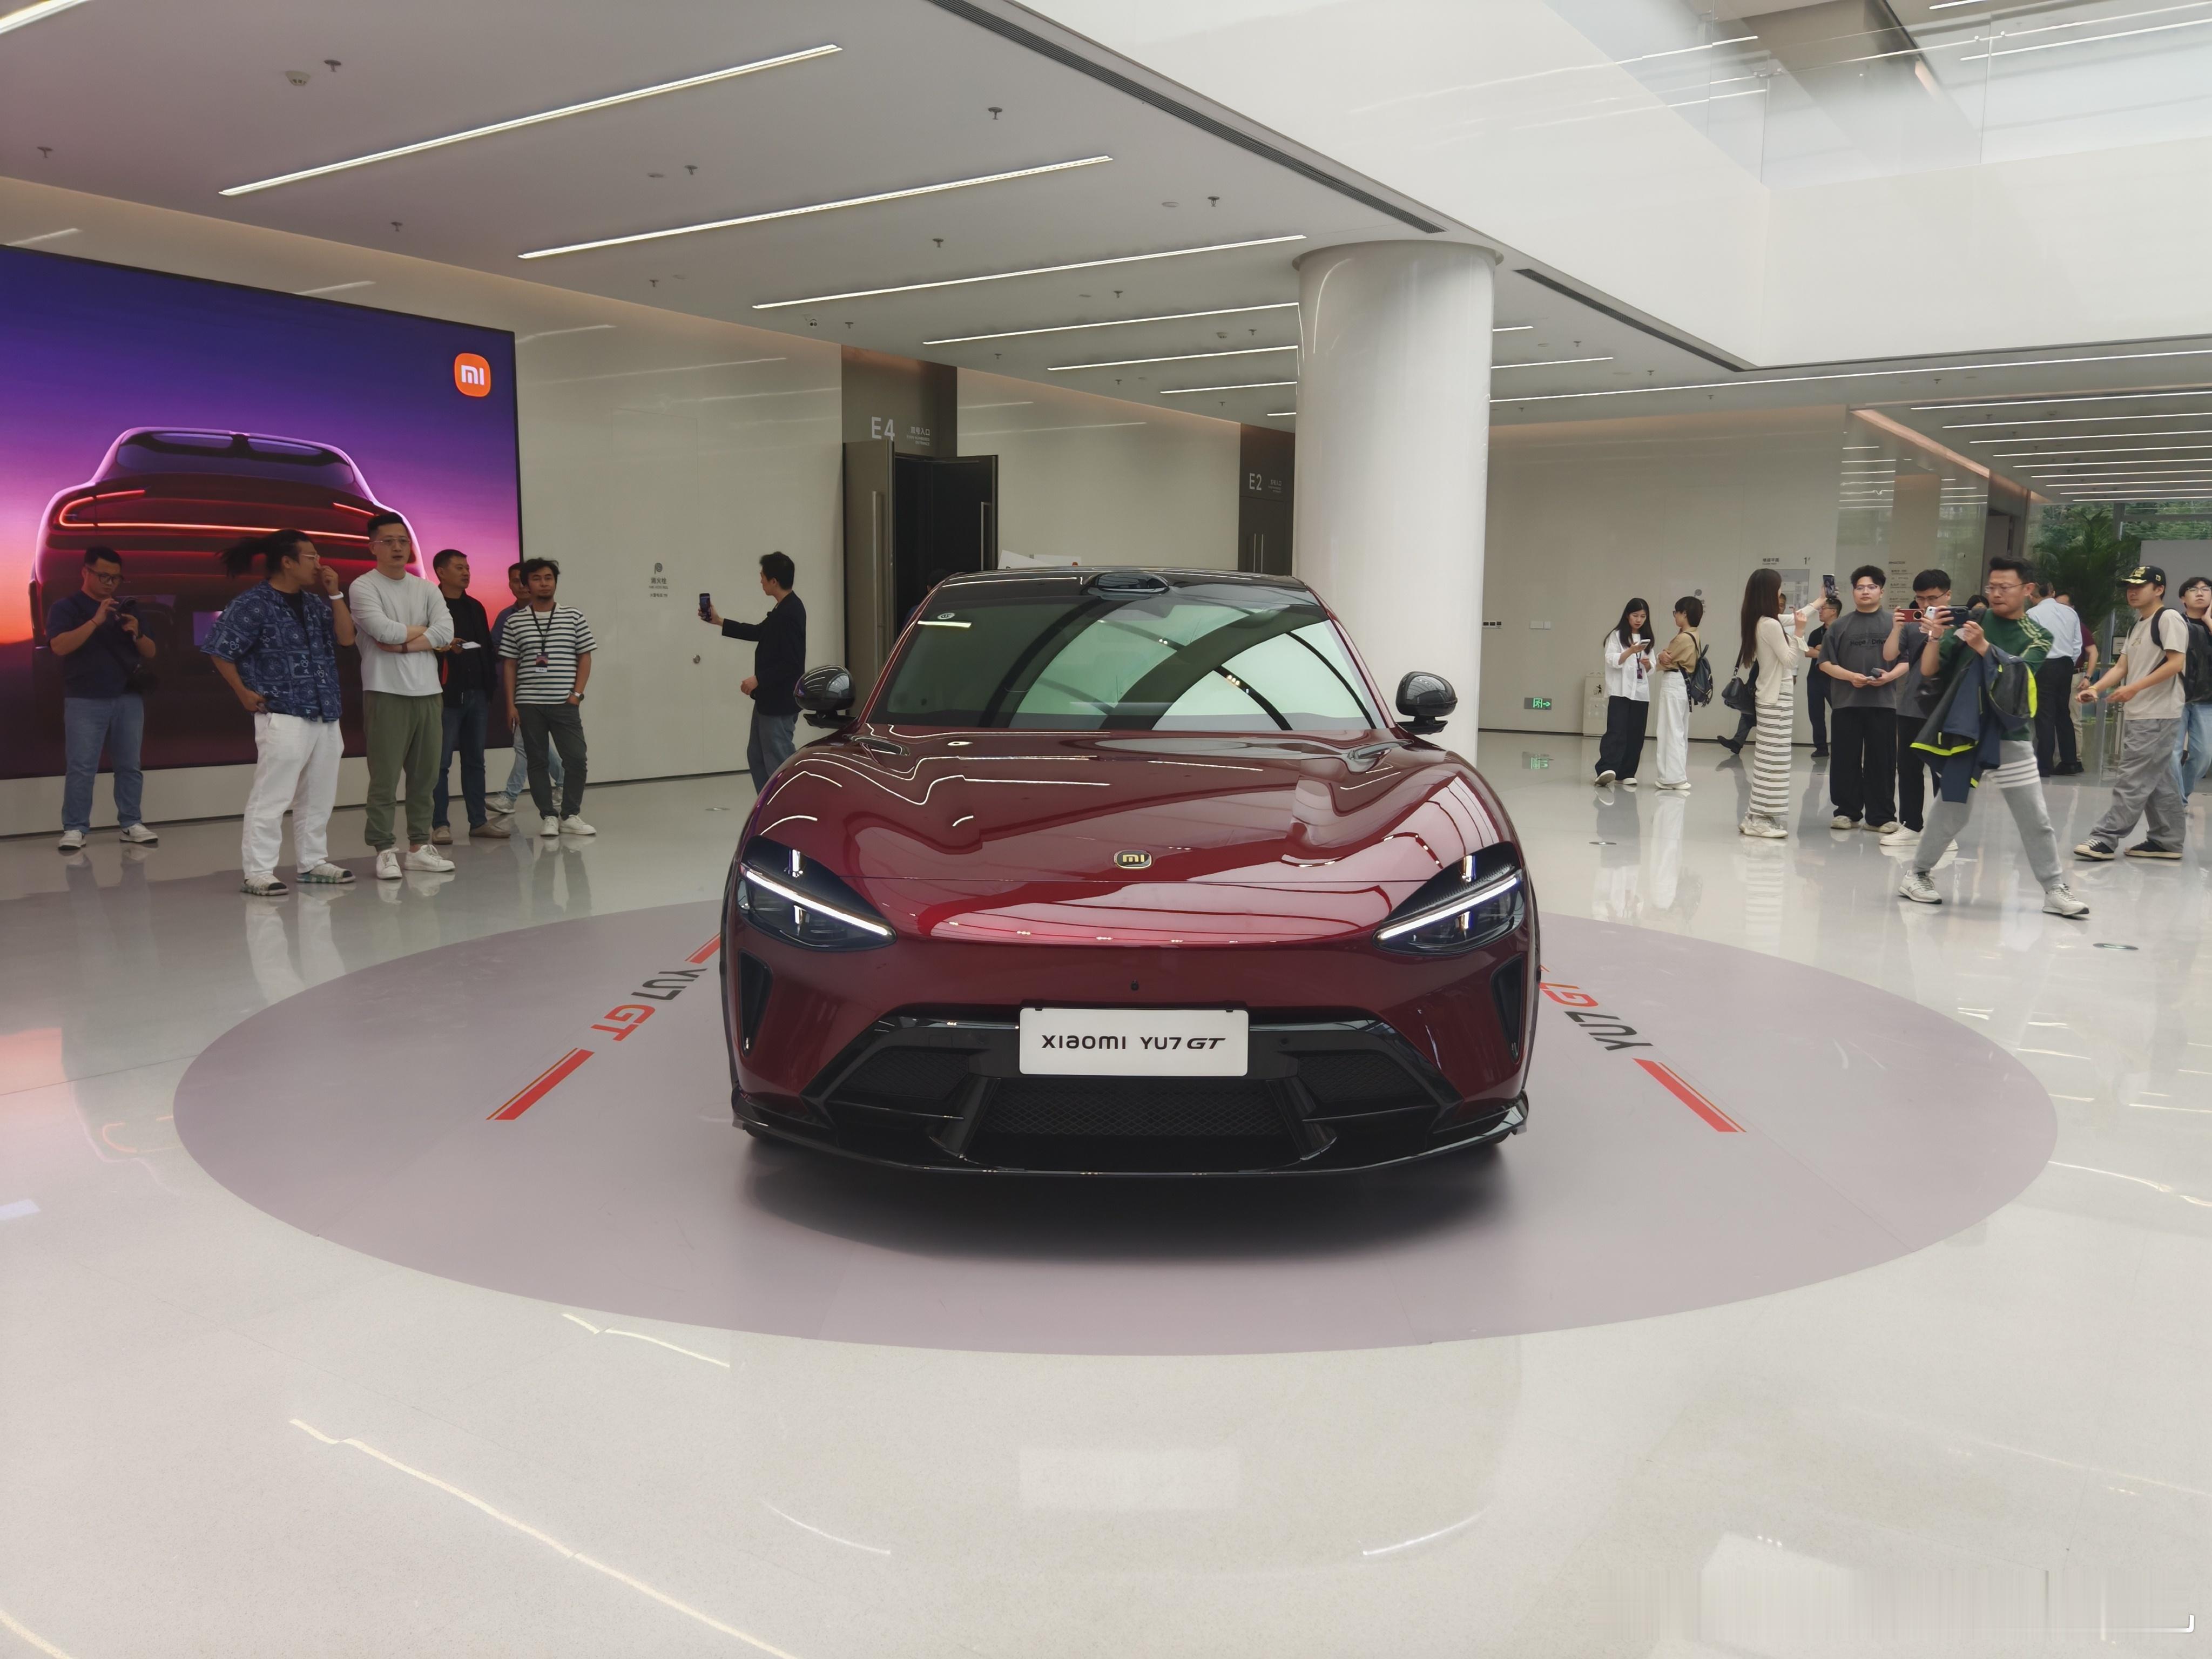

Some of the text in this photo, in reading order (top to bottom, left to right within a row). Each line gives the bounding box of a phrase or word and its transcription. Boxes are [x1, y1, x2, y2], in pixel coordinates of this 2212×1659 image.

[872, 416, 895, 441] E4
[1249, 473, 1262, 491] E2
[590, 968, 707, 1042] YU7 GT
[1139, 1036, 1182, 1050] YU7
[1186, 1037, 1226, 1050] GT
[1564, 1011, 1654, 1051] YU7
